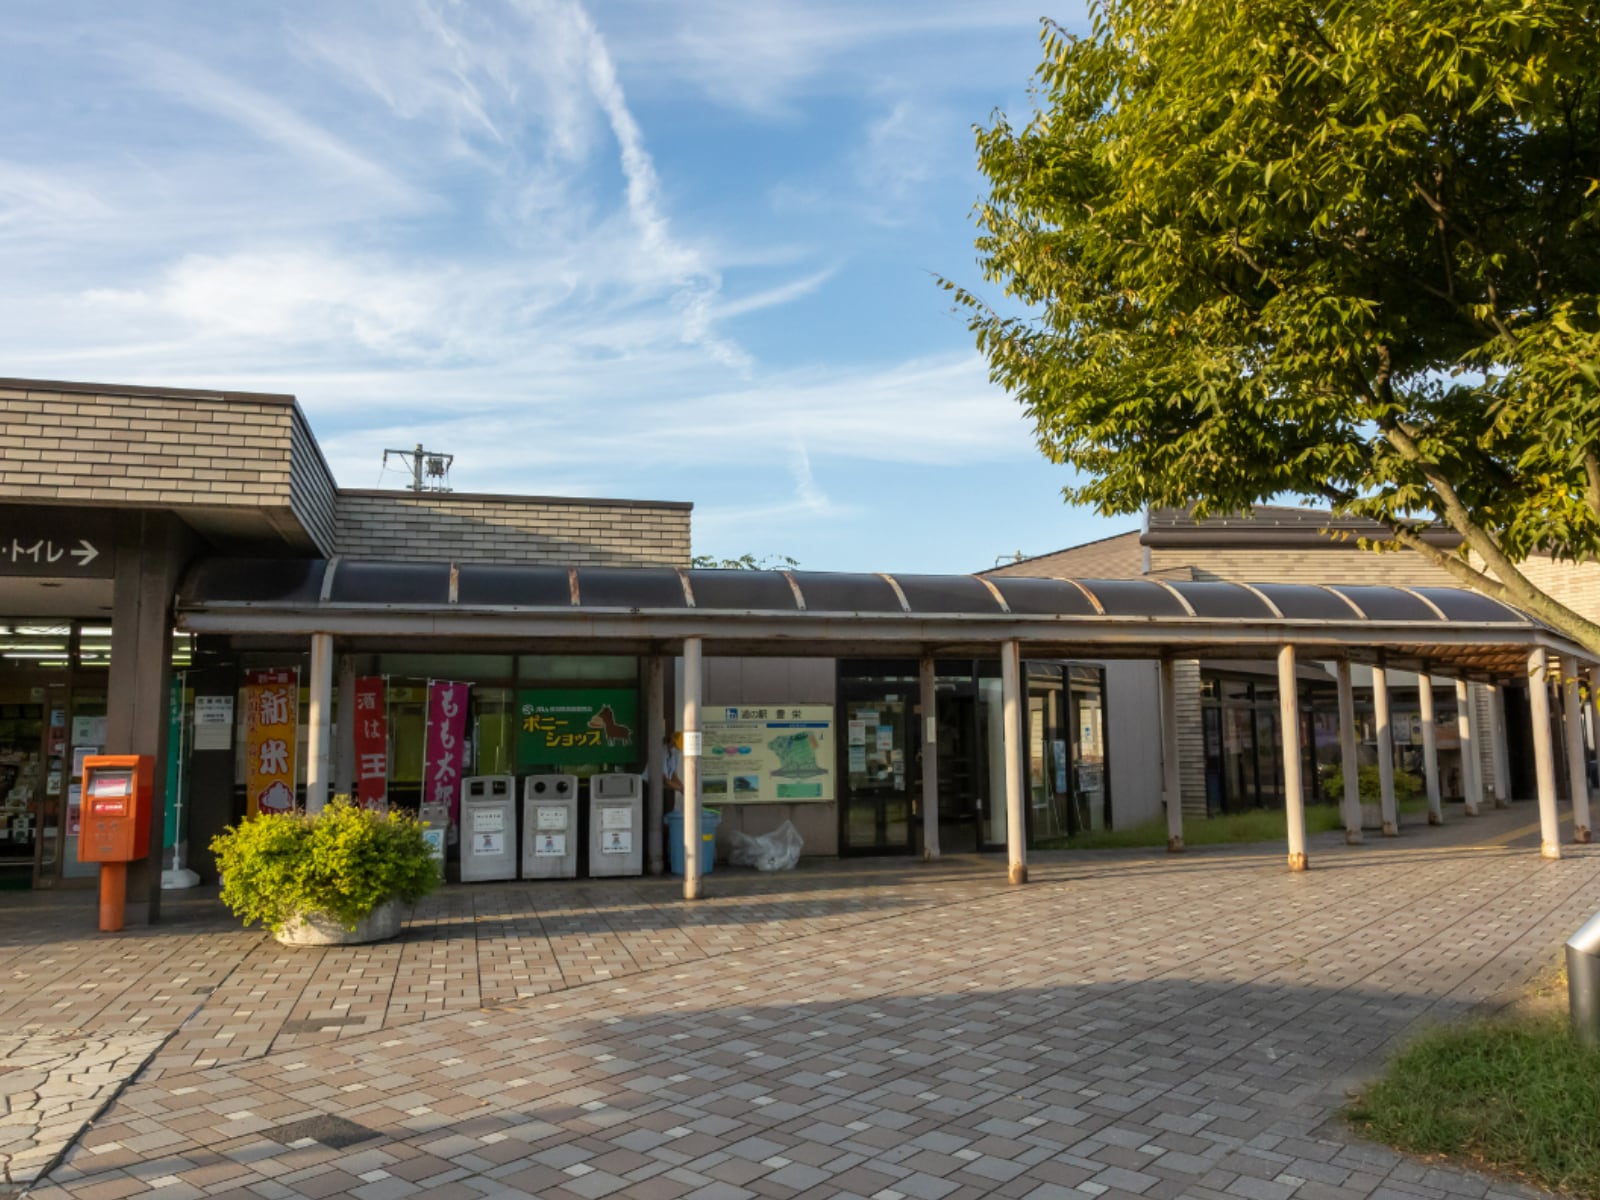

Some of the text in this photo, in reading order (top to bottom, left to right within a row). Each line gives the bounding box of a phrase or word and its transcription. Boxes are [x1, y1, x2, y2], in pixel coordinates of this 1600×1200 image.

[259, 688, 289, 775] 新米
[433, 688, 459, 807] もも太郎
[522, 714, 569, 733] ポニー
[545, 730, 602, 748] ショップ
